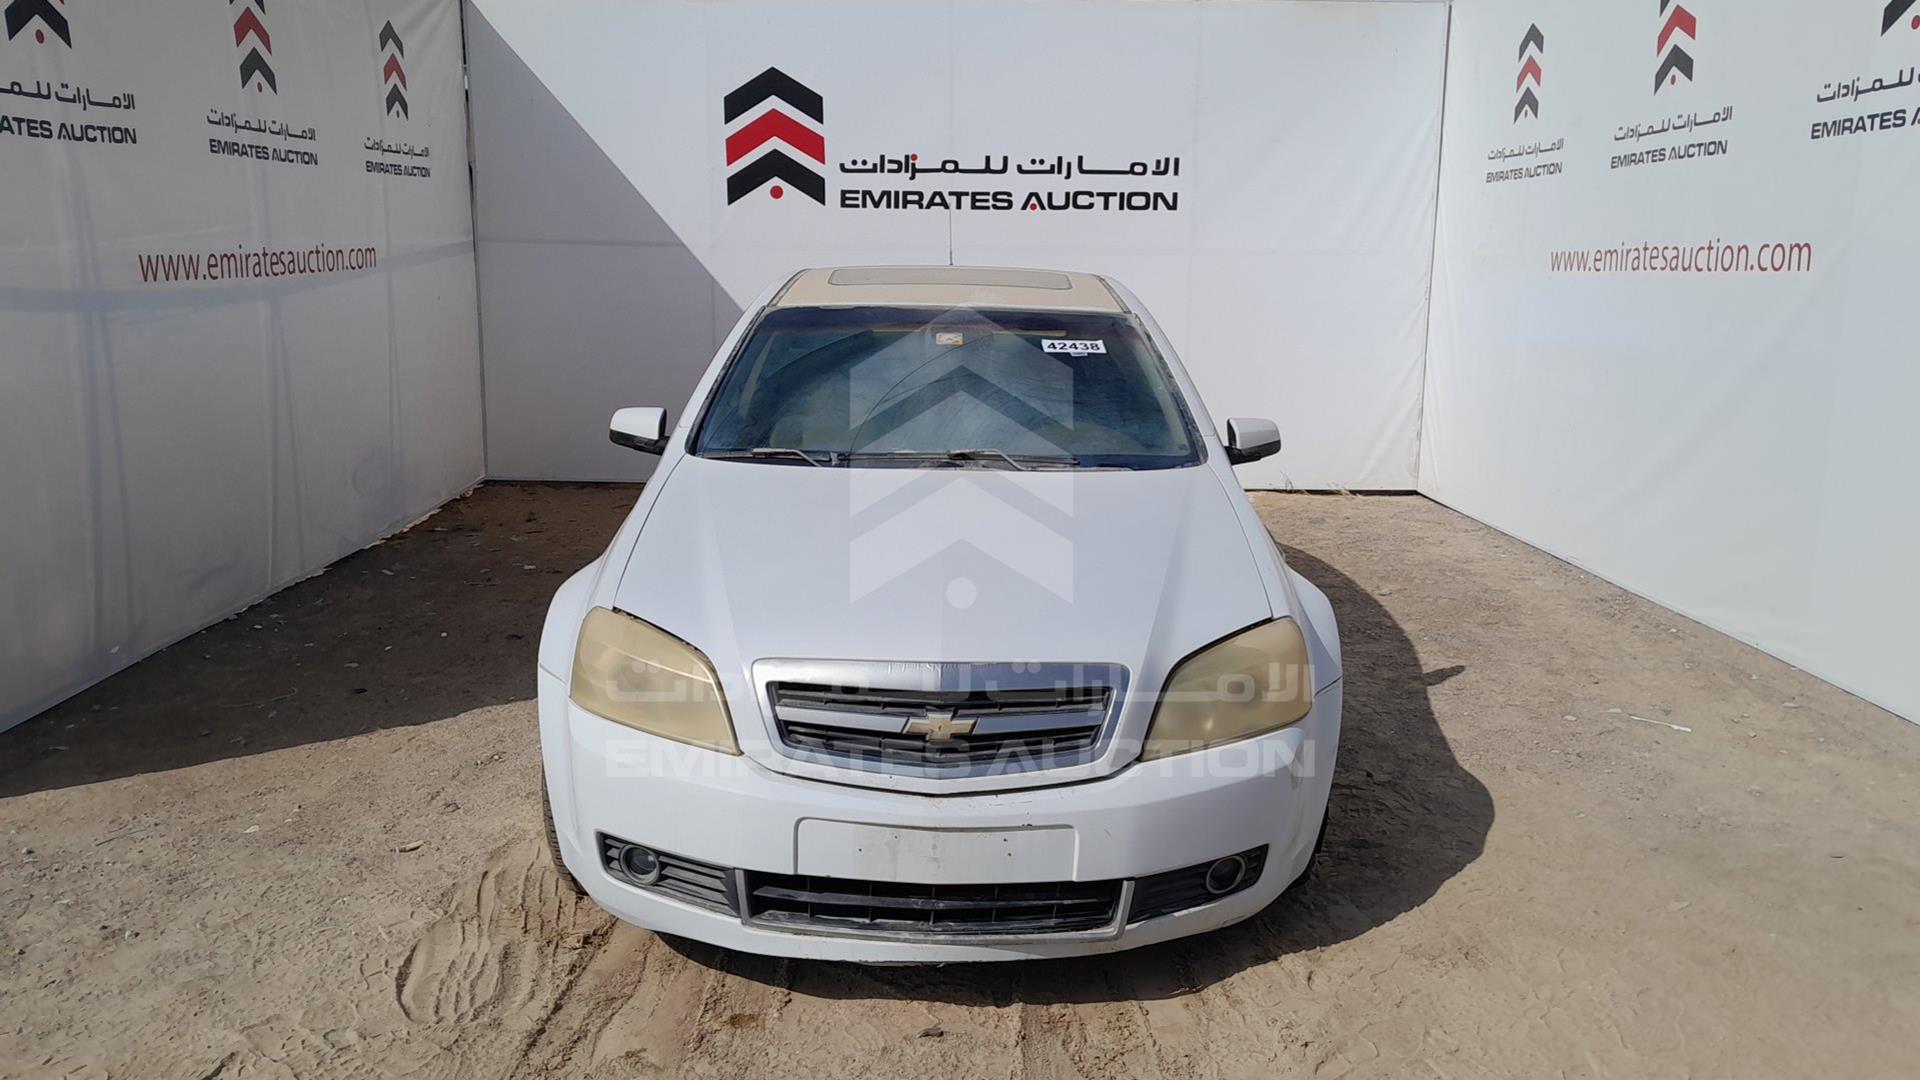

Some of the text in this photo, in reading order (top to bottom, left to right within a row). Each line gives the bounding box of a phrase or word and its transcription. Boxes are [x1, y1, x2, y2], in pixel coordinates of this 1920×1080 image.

[55, 82, 136, 111] الامارات
[1817, 66, 1915, 103] للمزادات
[57, 122, 137, 145] AUCTION
[206, 108, 317, 141] الامارات للمزادات
[1614, 105, 1733, 143] الامارات للمزادات
[1811, 108, 1907, 140] EMIRATES
[209, 138, 319, 166] EMIRATES AUCTION
[1610, 139, 1728, 169] EMIRATES AUCTION
[366, 160, 431, 178] EMIRATES AUCTION
[839, 153, 1180, 181] الامارات للمزادات
[1486, 161, 1563, 183] EMIRATES AUCTION
[840, 189, 1178, 211] EMIRATES AUCTION
[138, 243, 377, 283] www.emiratesauction.com
[1550, 237, 1813, 273] www.emiratesauction.com
[1047, 341, 1101, 351] 42438
